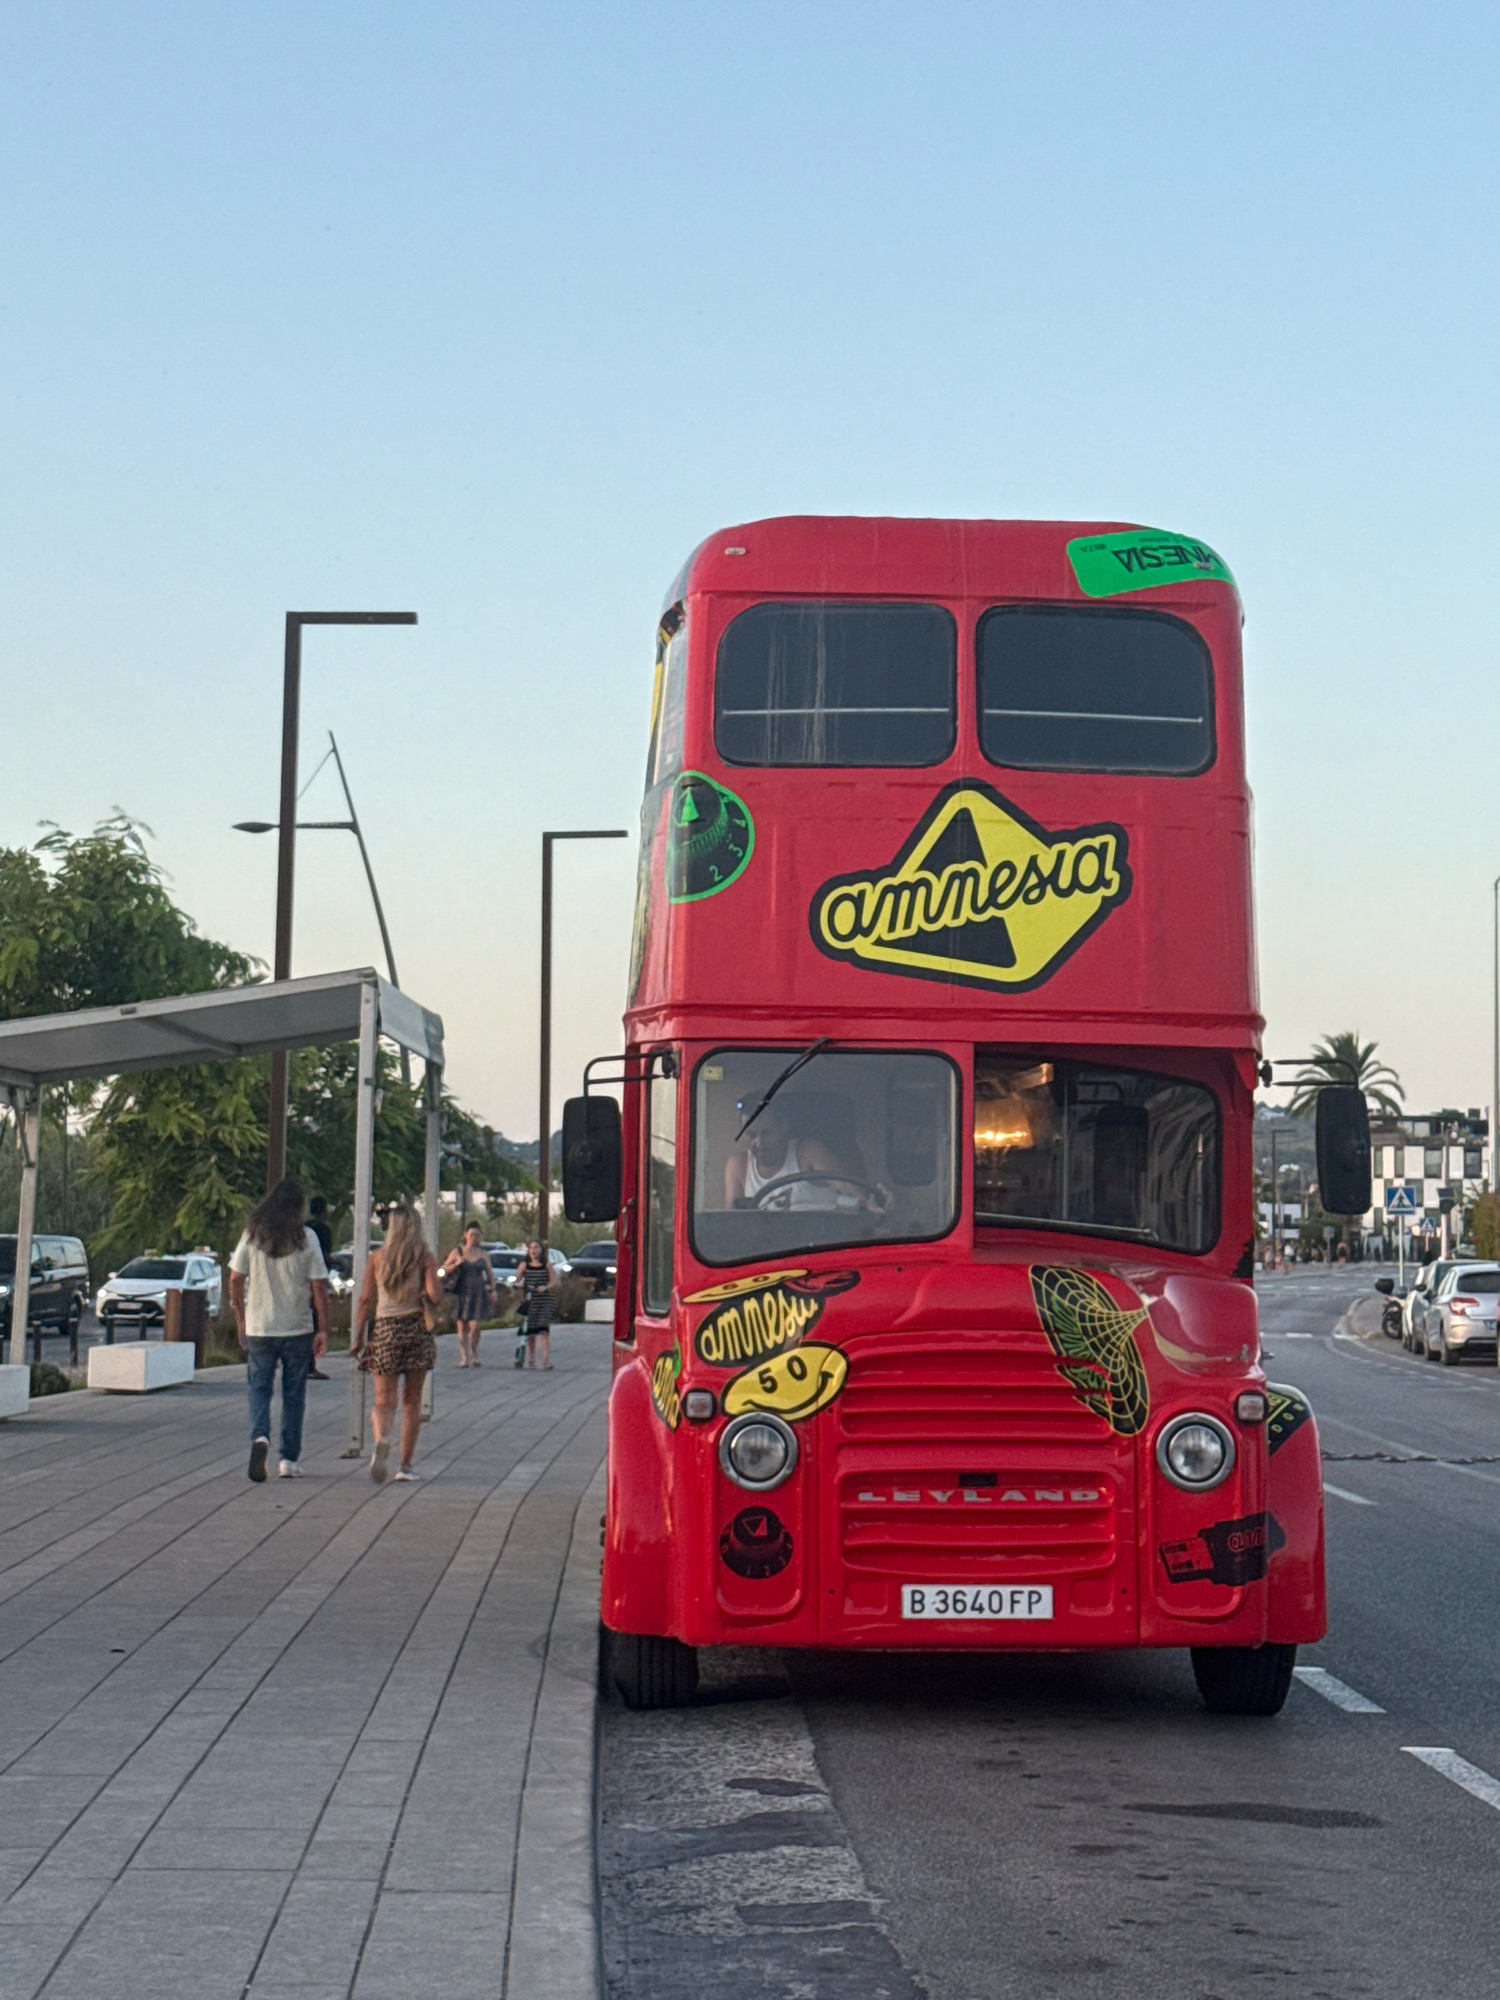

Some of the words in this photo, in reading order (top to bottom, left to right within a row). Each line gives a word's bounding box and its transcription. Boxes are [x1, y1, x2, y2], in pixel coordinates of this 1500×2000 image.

[709, 864, 724, 882] 2
[826, 840, 1114, 941] amnesia
[857, 1489, 1101, 1503] LEYLAND
